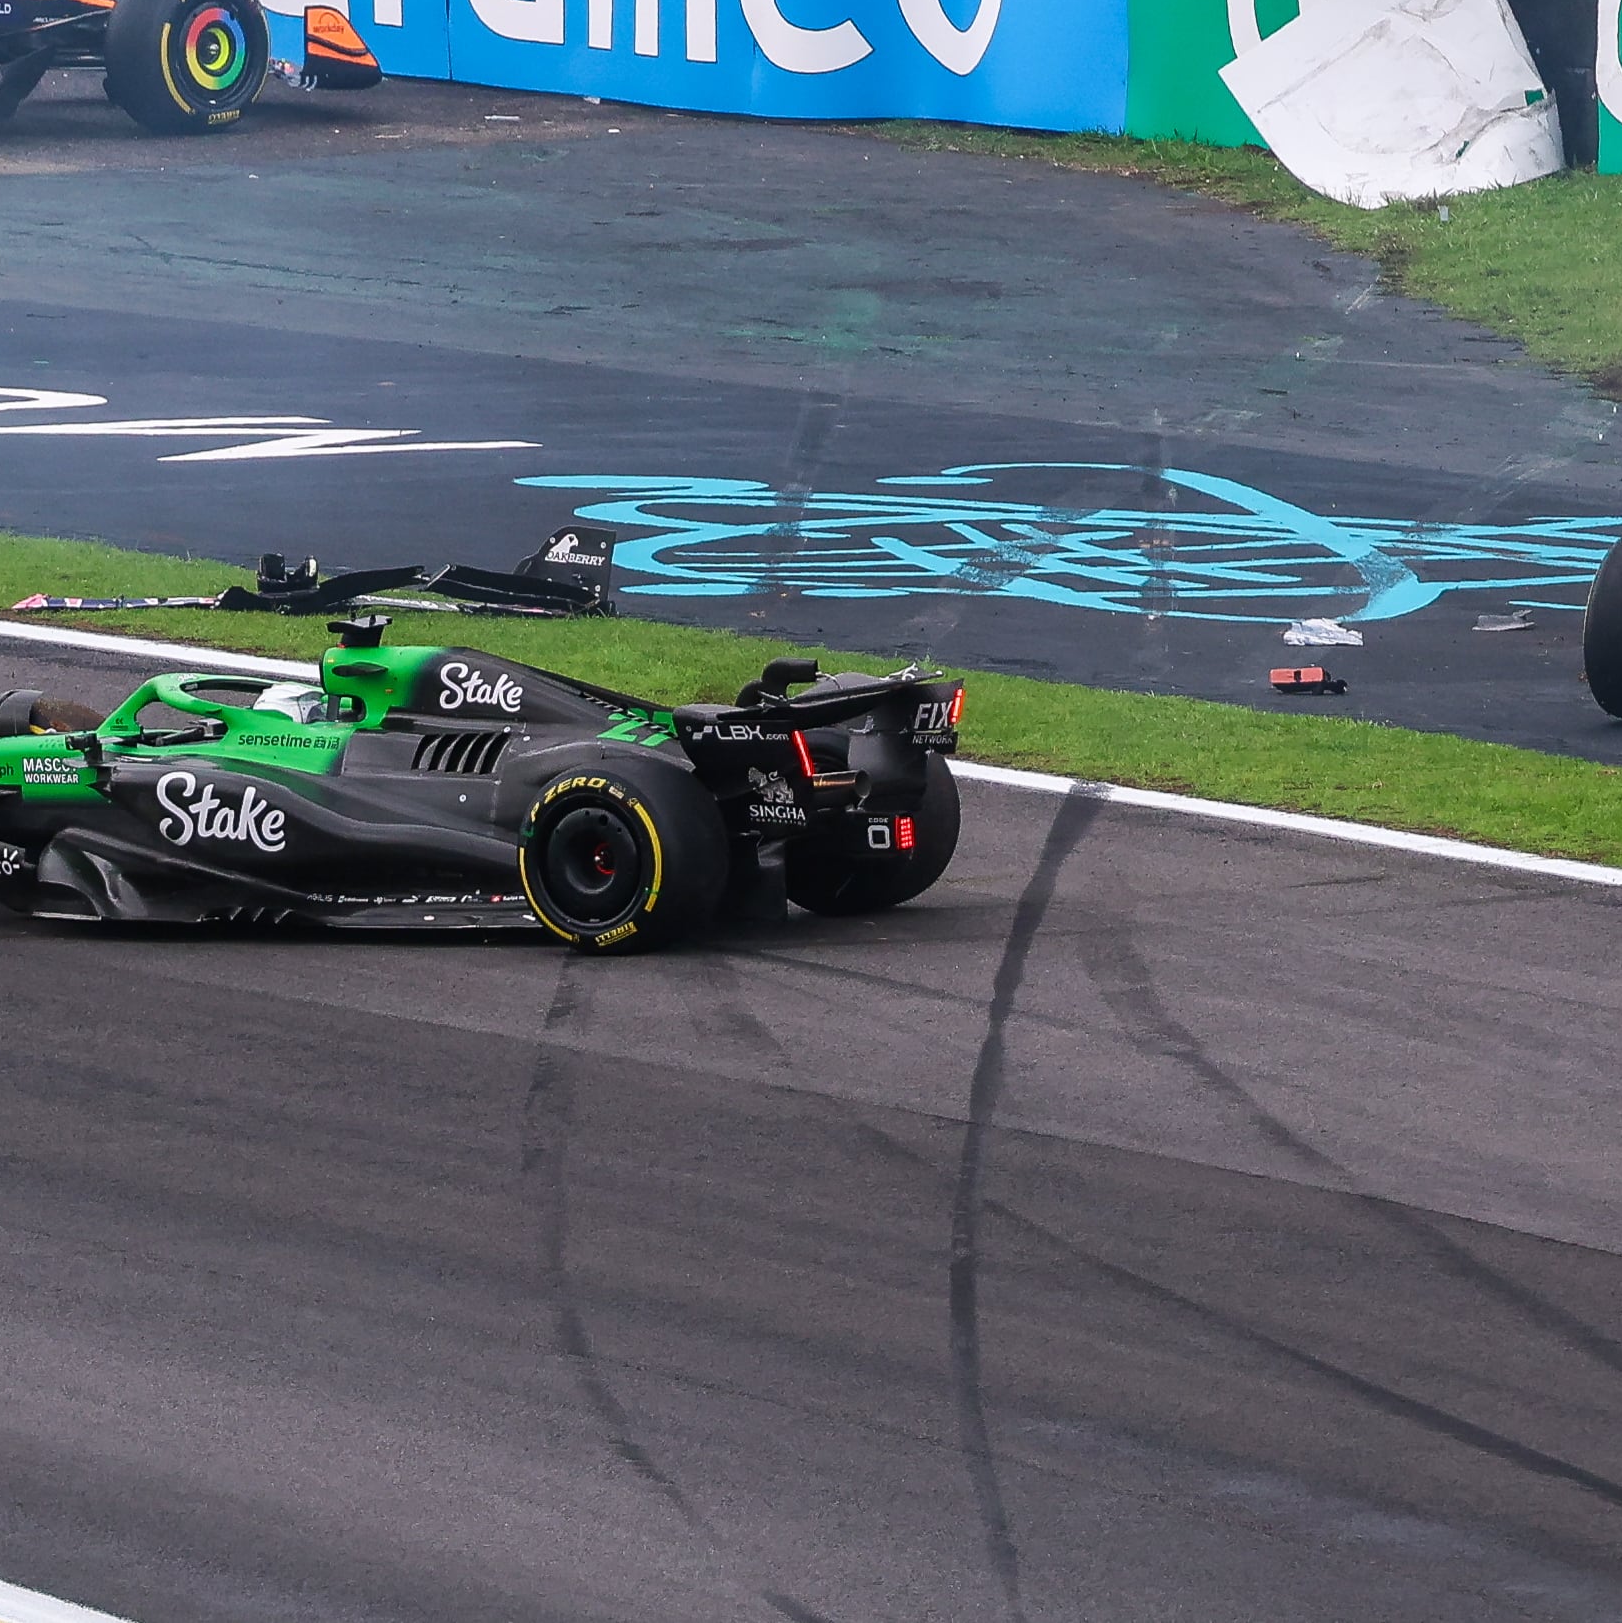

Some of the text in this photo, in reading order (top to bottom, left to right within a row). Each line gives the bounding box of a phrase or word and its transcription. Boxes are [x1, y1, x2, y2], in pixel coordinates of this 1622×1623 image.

[546, 551, 606, 566] OAKBERRY
[440, 663, 523, 712] Stake
[914, 701, 953, 729] FIX
[238, 733, 311, 749] sensetime
[912, 734, 953, 745] NETWORK
[23, 758, 78, 773] MASC
[24, 773, 79, 784] WORKWEAR
[530, 802, 540, 823] P
[544, 777, 608, 804] ZERO
[157, 771, 286, 852] Stake
[749, 804, 806, 820] SINGHA
[595, 921, 638, 946] PIRELLI
